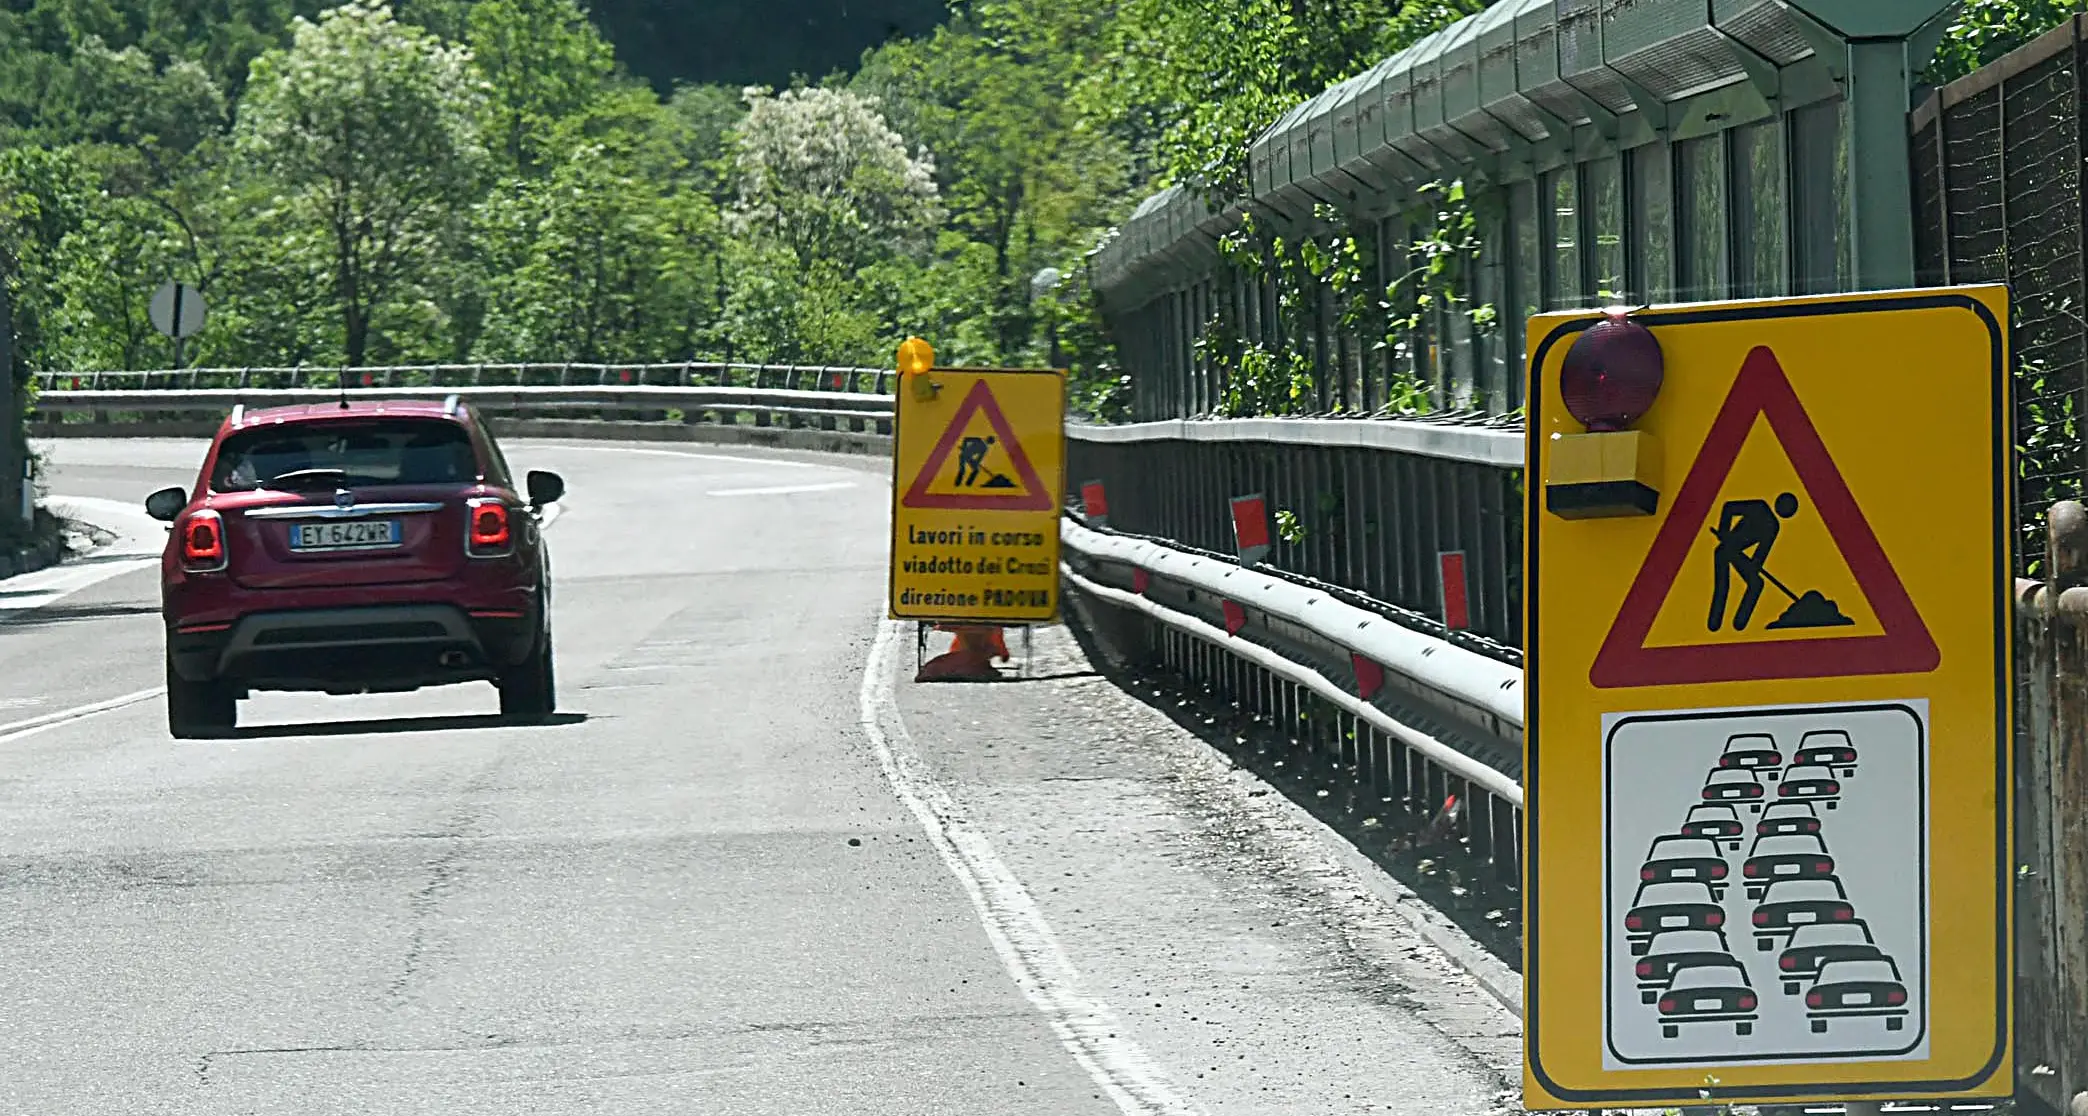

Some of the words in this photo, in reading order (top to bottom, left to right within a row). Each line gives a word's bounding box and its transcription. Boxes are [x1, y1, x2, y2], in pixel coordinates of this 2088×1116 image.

[302, 526, 324, 545] EY
[331, 523, 389, 543] 642WR
[968, 526, 985, 545] in
[992, 532, 1043, 546] corso
[903, 556, 972, 574] viadotto
[976, 557, 1002, 574] dei
[900, 587, 979, 606] direzione
